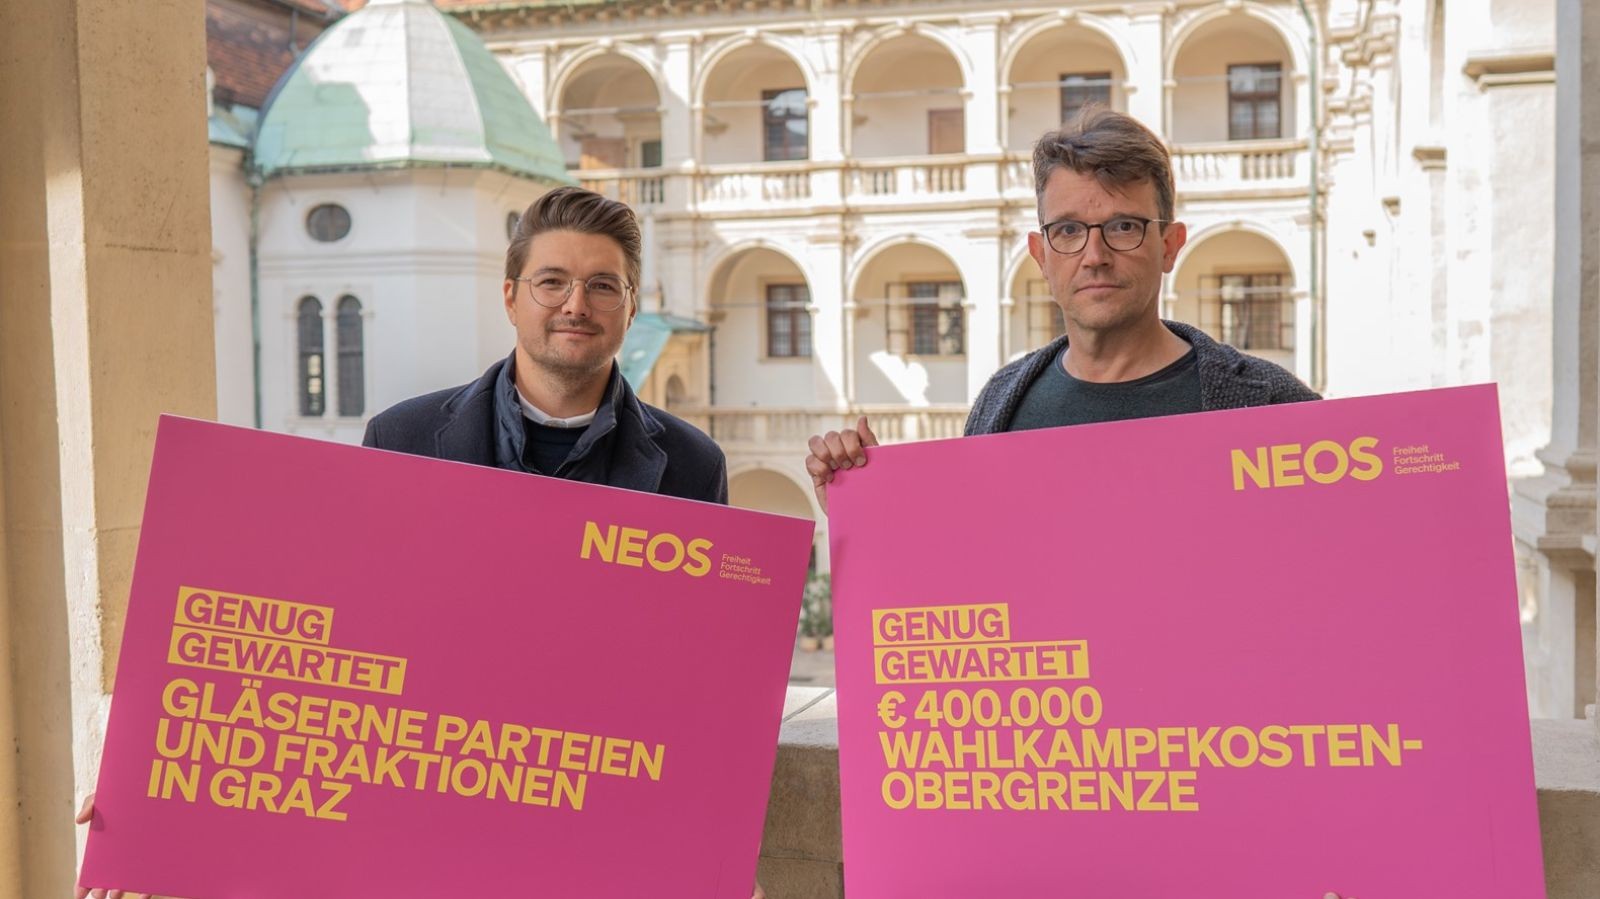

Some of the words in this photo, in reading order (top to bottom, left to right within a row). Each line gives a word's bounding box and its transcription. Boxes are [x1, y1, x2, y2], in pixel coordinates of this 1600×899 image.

[1231, 437, 1383, 490] NEOS
[1393, 445, 1429, 455] Freiheit
[1394, 454, 1444, 464] Fortschritt
[1395, 462, 1460, 474] Gerechtigkeit
[580, 522, 713, 577] NEOS
[720, 562, 761, 575] Fortschritt
[722, 554, 751, 565] Freiheit
[720, 570, 771, 585] Gerechtigkeit
[183, 592, 324, 641] GENUG
[879, 607, 1004, 642] GENUG
[177, 632, 400, 690] GEWARTET
[881, 644, 1081, 680] GEWARTET
[877, 690, 908, 729] €
[914, 685, 1103, 728] 400.000
[162, 678, 426, 749] GLÄSERNE
[435, 715, 665, 780] PARTEIEN
[878, 724, 1423, 769] WAHLKAMPFKOSTEN-
[156, 719, 265, 770] UND
[275, 735, 587, 810] FRAKTIONEN
[148, 760, 201, 801] IN
[210, 768, 351, 820] GRAZ
[881, 770, 1199, 811] OBERGRENZE
